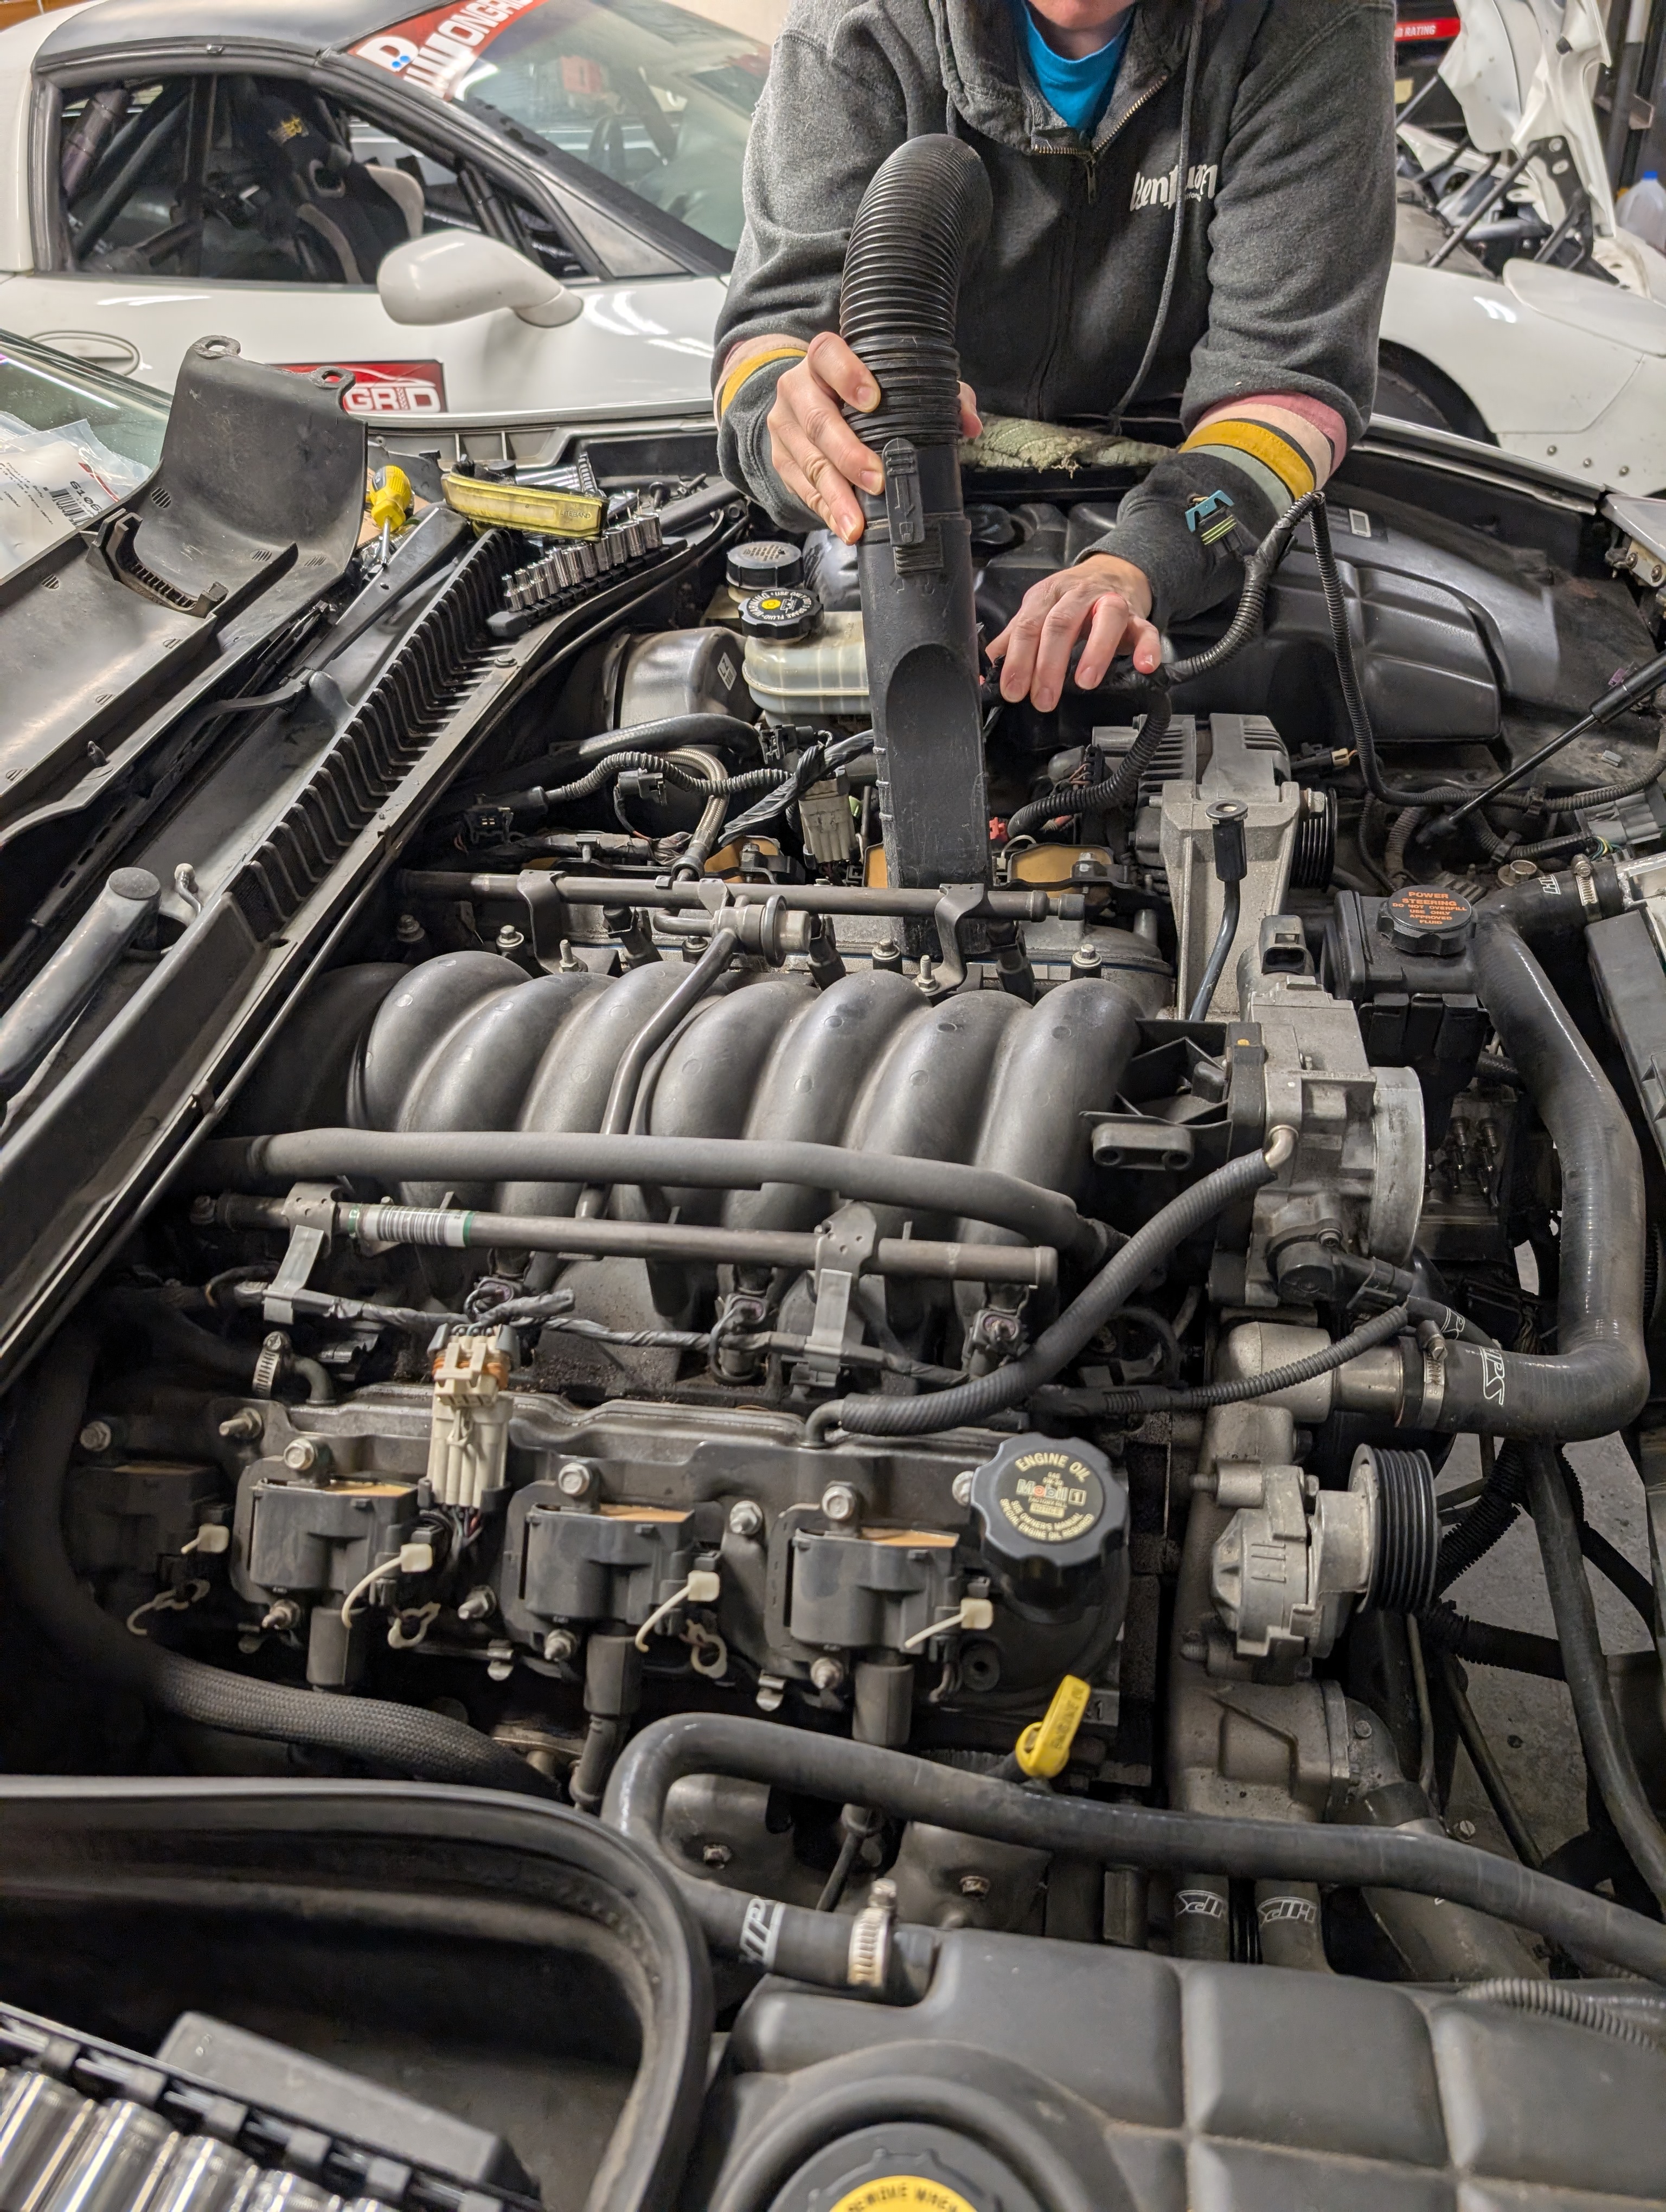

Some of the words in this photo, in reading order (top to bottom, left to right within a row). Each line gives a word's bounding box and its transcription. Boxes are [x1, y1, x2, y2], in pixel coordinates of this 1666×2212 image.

[70, 481, 103, 513] 6106
[560, 510, 591, 519] LITEBAND
[748, 592, 771, 618] WARNING
[786, 607, 808, 619] BRAKE
[1402, 898, 1457, 906] STEERING
[1014, 1452, 1070, 1472] ENGINE
[1068, 1461, 1091, 1483] OIL
[1016, 1478, 1069, 1501] Mobil
[999, 1498, 1020, 1527] SPECIAL
[1018, 1522, 1047, 1540] ENGINE
[1048, 1531, 1063, 1541] OIL
[1062, 1513, 1095, 1539] REQUIRED
[1054, 1512, 1084, 1531] MANUAL
